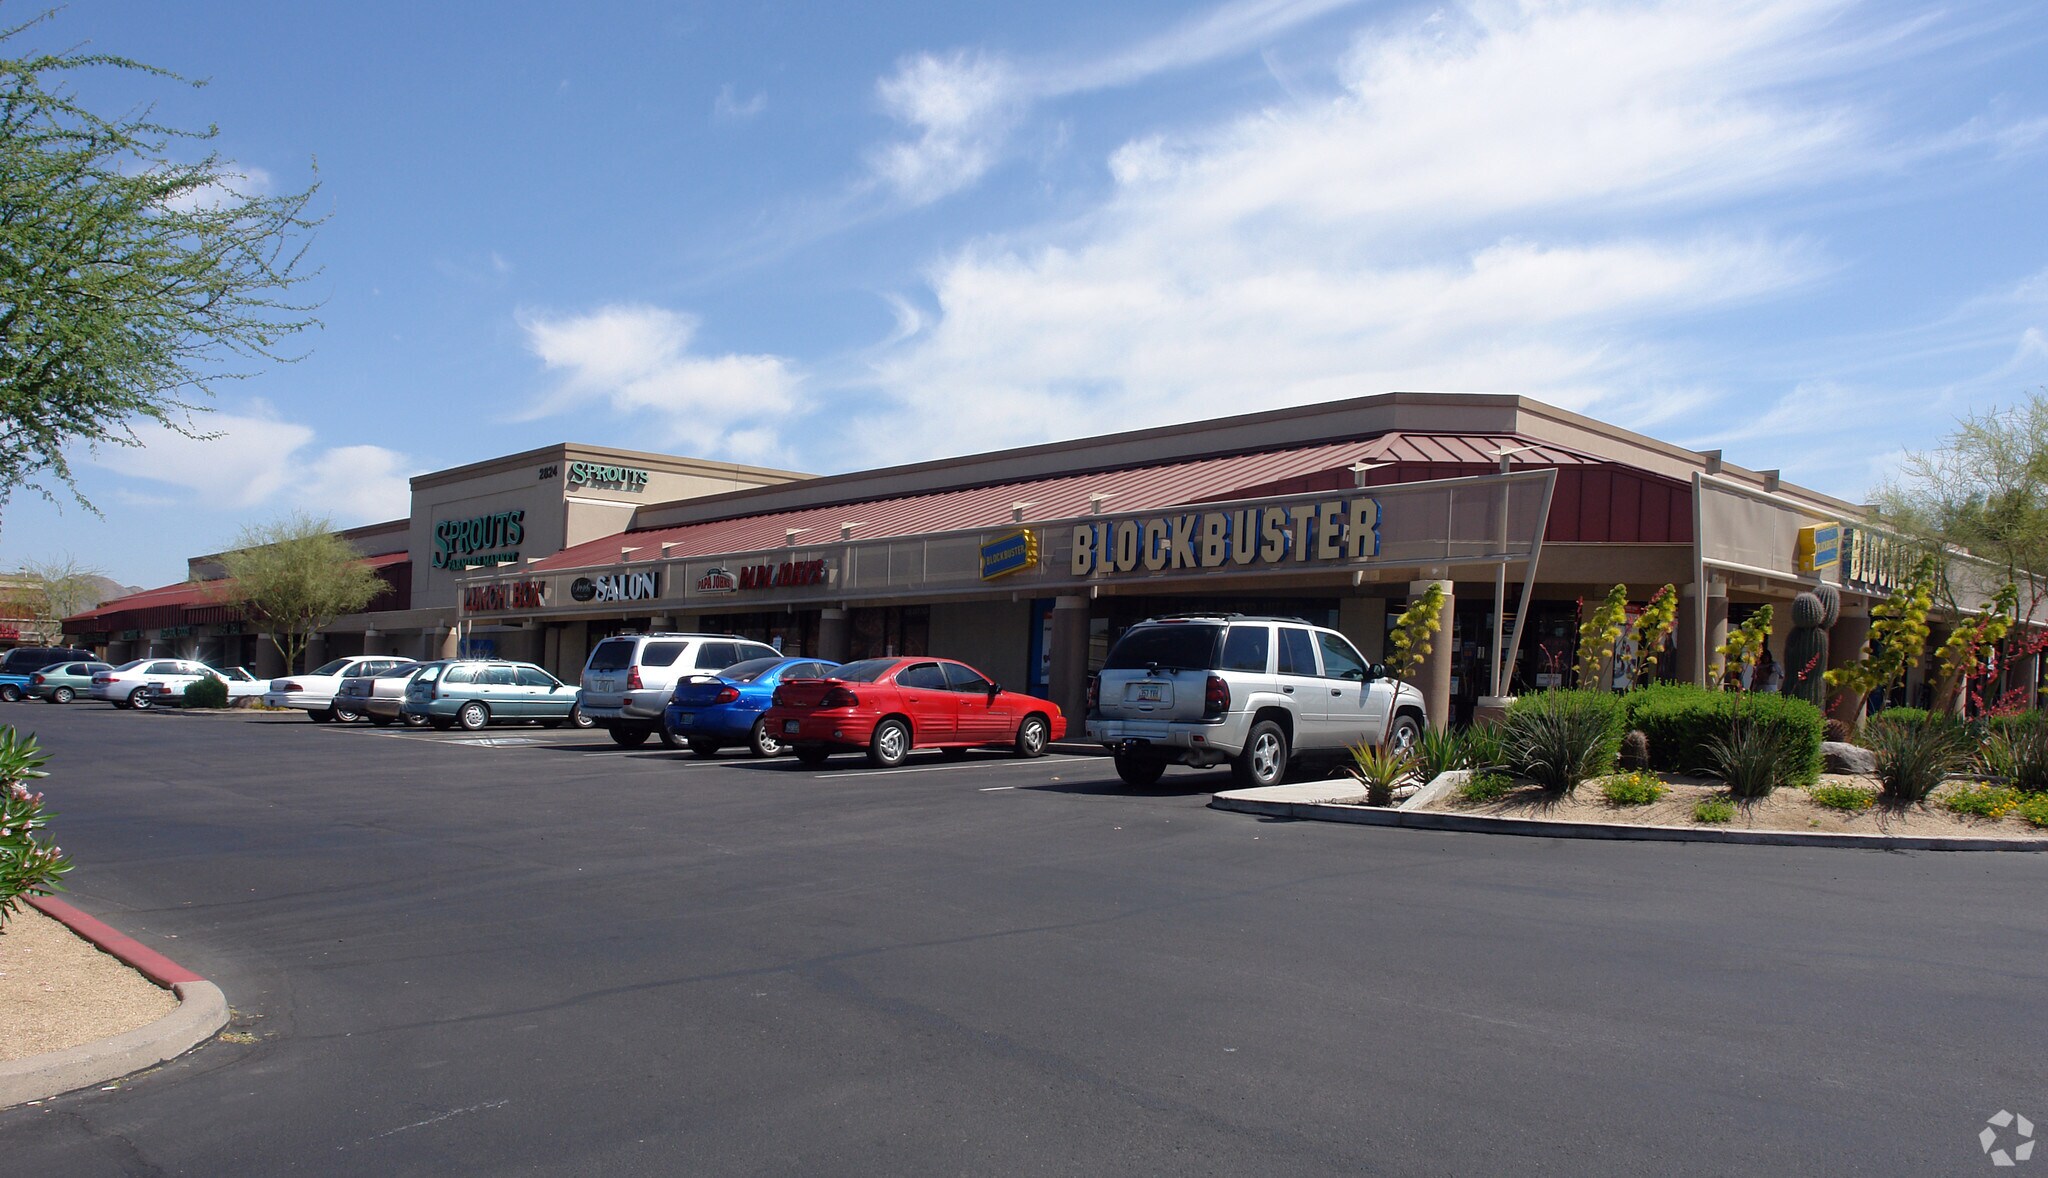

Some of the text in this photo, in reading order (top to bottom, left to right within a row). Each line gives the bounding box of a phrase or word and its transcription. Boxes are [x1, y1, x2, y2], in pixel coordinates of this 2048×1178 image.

[539, 466, 558, 480] 2824
[571, 461, 649, 485] SPROUTS
[432, 511, 524, 569] SPROUTS
[1071, 498, 1382, 576] BLOCKBUSTER
[482, 552, 519, 568] MARKET
[986, 545, 1025, 566] BLOCKBUSTER
[595, 572, 660, 602] SALON
[697, 576, 711, 590] PAPA
[739, 565, 775, 590] PAPA
[464, 583, 508, 611] LUNCH
[512, 581, 543, 608] BOX
